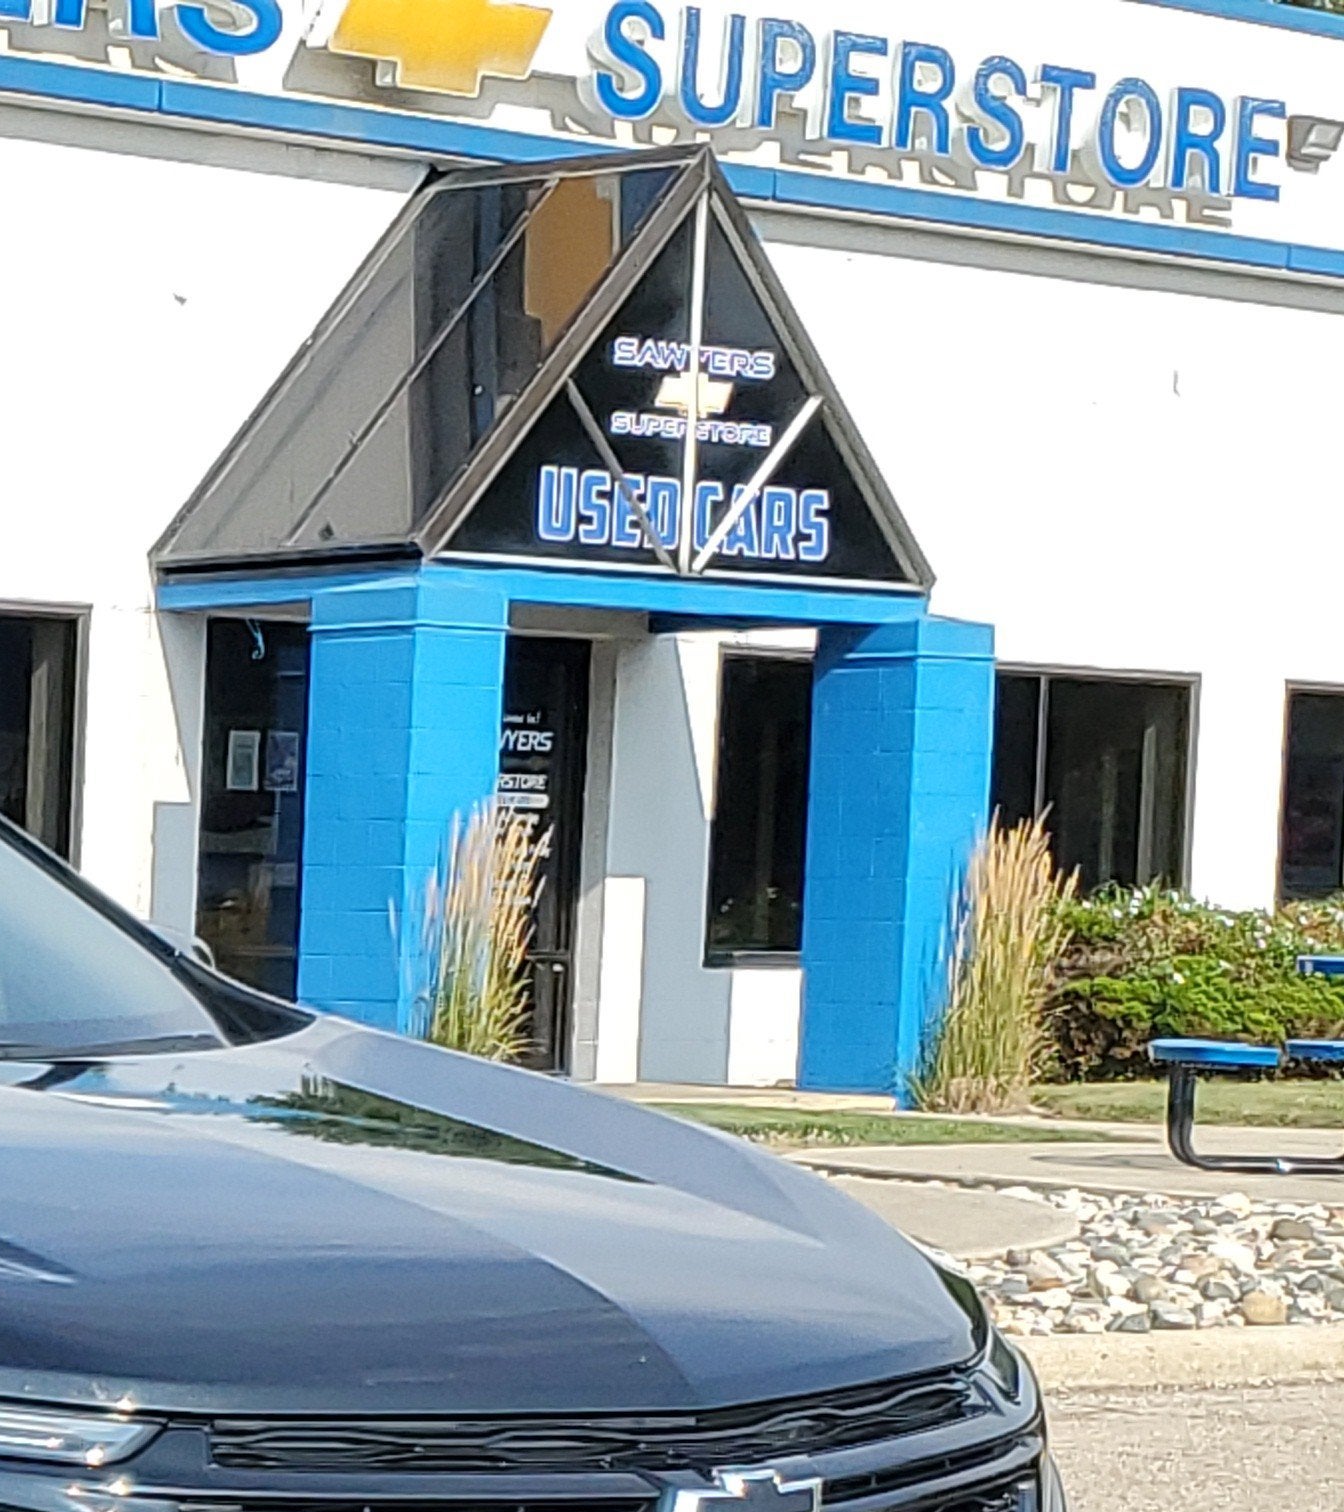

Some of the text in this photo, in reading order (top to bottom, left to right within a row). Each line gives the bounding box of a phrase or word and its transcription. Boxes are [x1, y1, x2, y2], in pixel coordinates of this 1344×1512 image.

[592, 0, 1287, 201] SUPERSTORE
[537, 466, 830, 562] USED CARS
